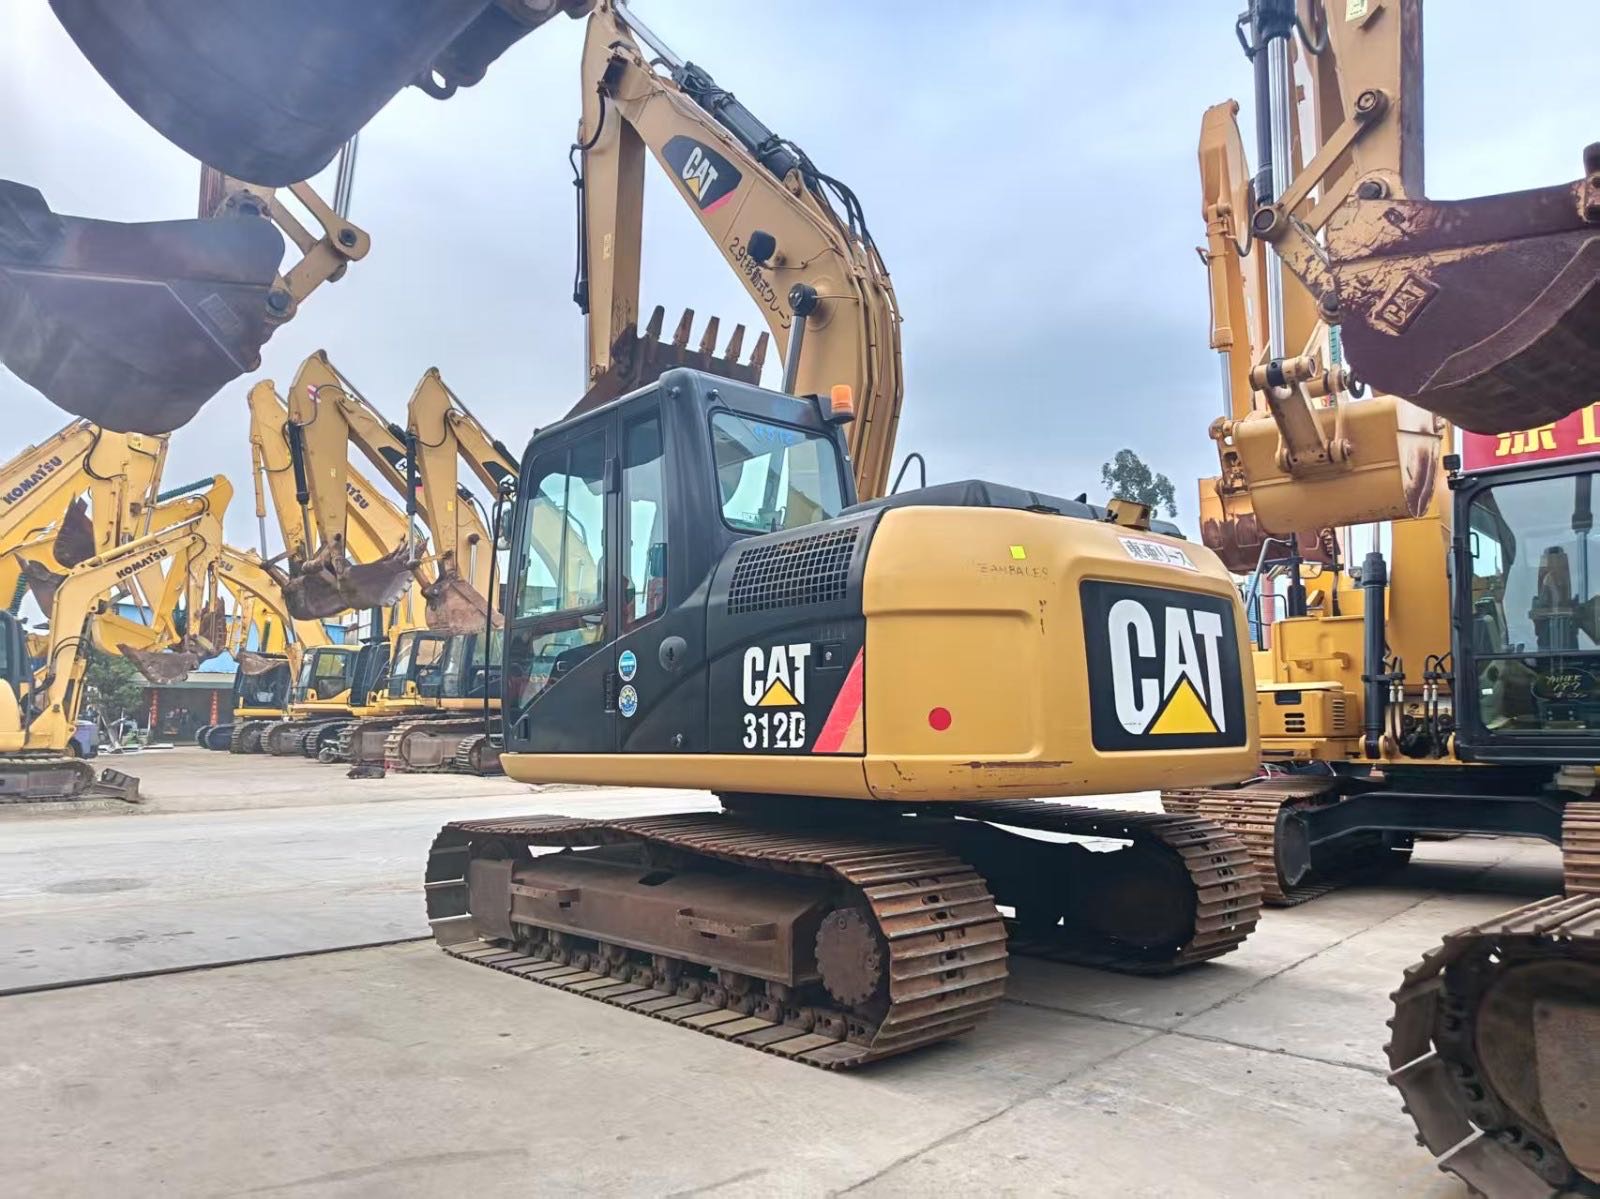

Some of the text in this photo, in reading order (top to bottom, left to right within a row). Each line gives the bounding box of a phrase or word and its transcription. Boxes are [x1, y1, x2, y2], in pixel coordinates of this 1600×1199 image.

[682, 147, 718, 202] CAT
[1383, 279, 1426, 326] CAT
[2, 456, 63, 505] KOMATSU
[116, 548, 168, 579] KOMATSU
[742, 643, 811, 707] CAT
[1108, 599, 1226, 735] CAT
[742, 711, 806, 749] 312D
